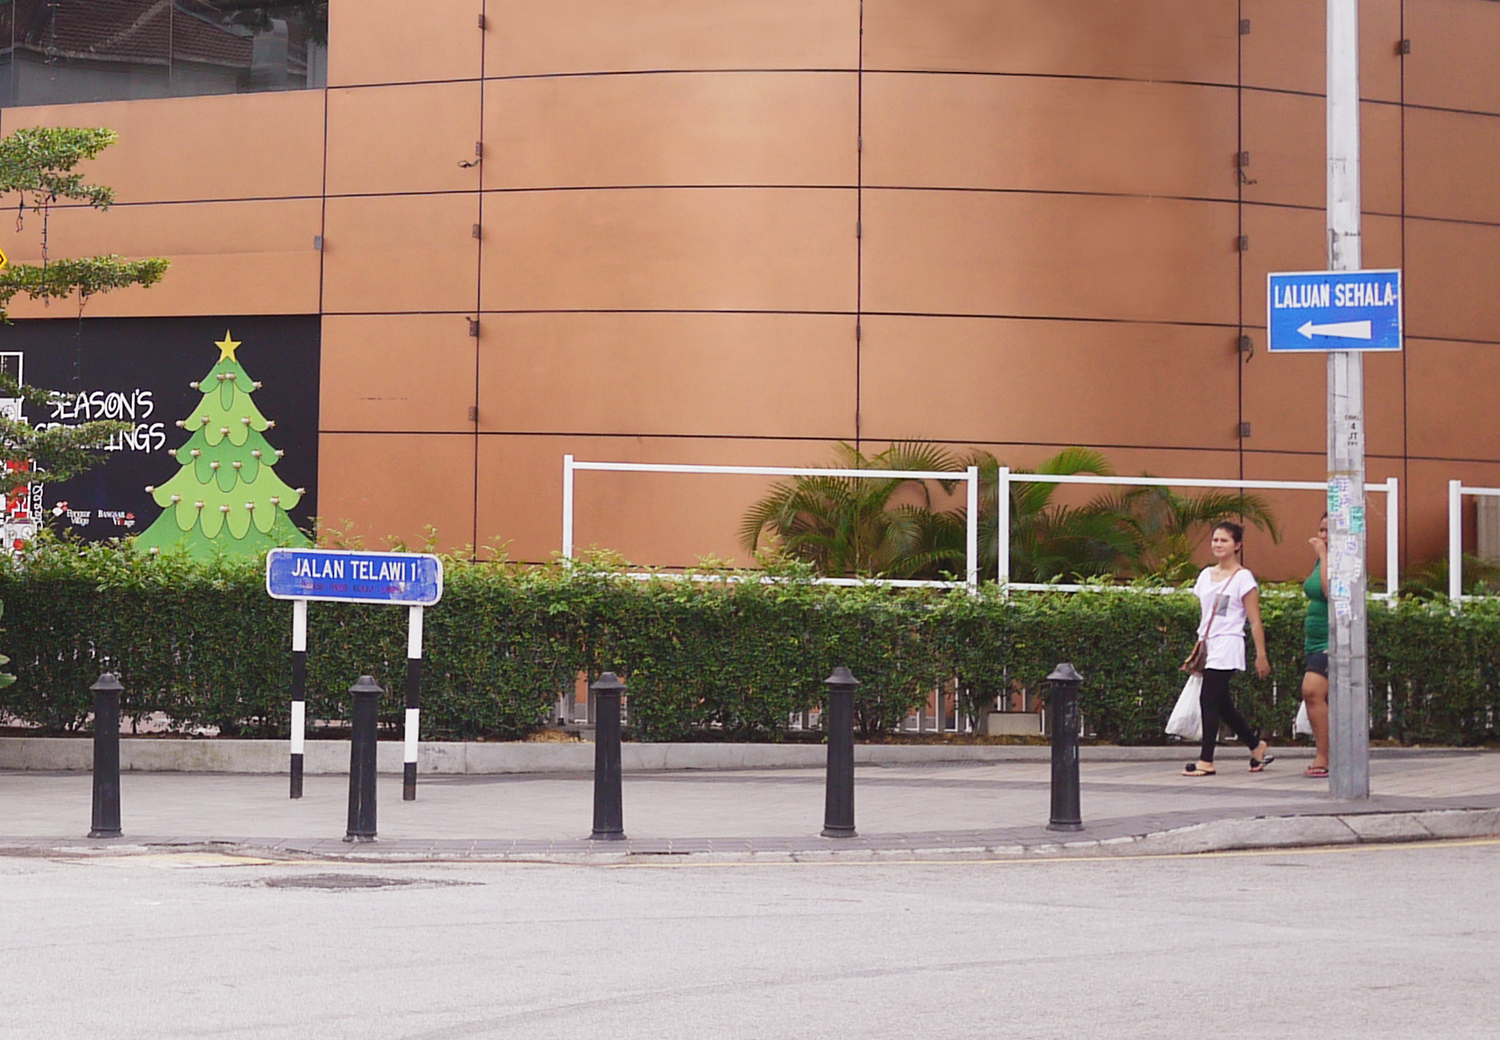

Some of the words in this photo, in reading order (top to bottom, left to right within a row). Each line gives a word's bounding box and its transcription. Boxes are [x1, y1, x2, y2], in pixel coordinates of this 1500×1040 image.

[1274, 283, 1330, 308] LALUAN
[1335, 282, 1394, 307] SEHALA
[46, 388, 154, 419] SEASON'S
[291, 558, 344, 579] JALAN
[350, 560, 406, 581] TELAWI
[411, 562, 417, 582] 1
